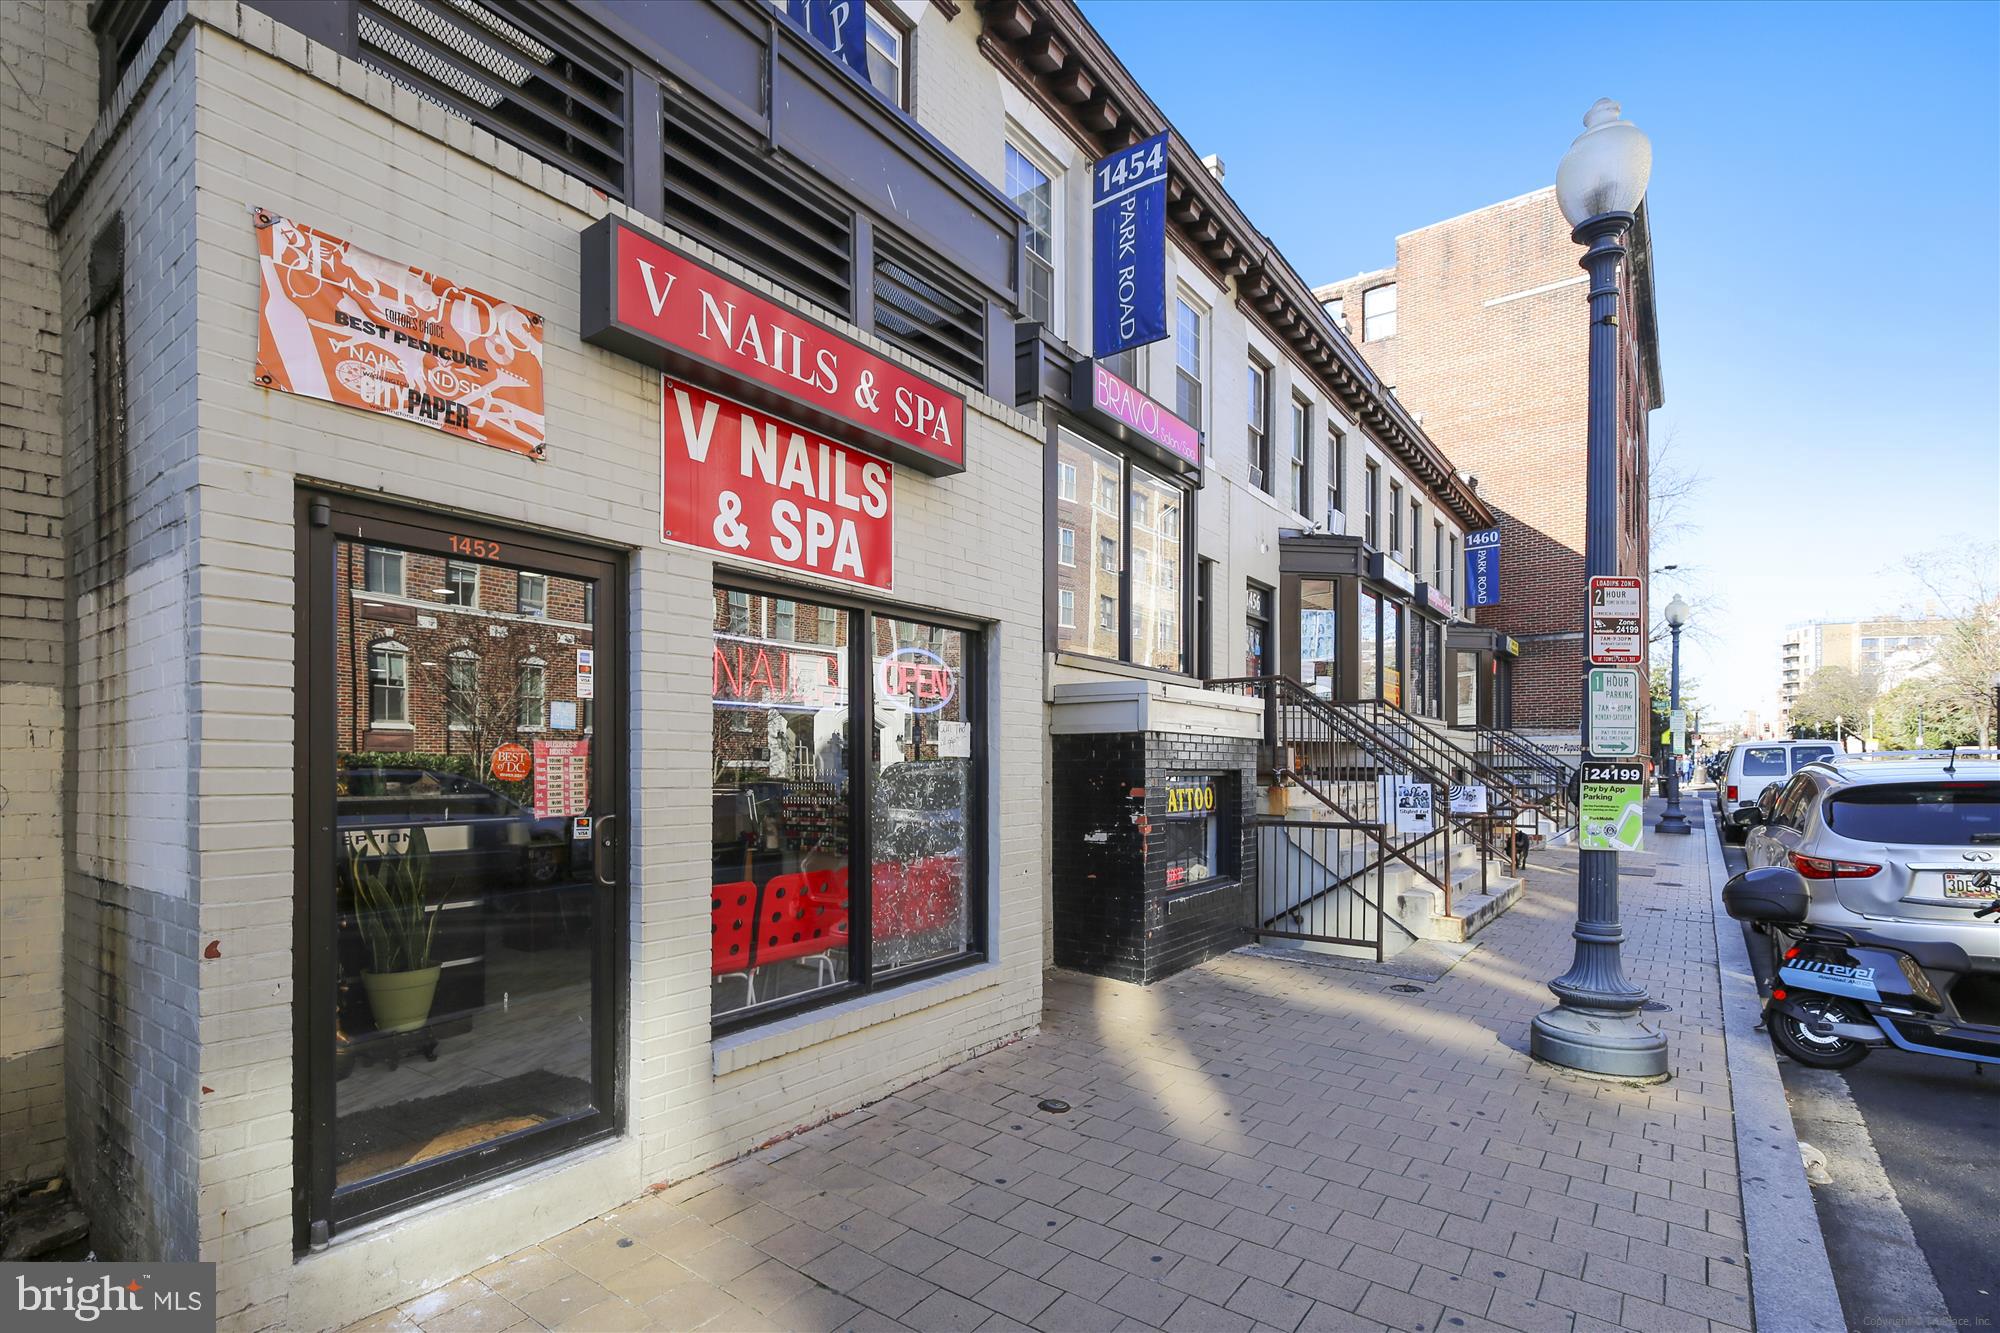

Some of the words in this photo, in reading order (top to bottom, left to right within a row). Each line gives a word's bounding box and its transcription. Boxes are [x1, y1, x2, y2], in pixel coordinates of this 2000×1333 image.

[1098, 142, 1164, 192] 1454
[1119, 195, 1136, 260] PARK
[1118, 269, 1135, 340] ROAD
[335, 311, 391, 339] BEST
[394, 329, 489, 372] PEDICURE
[419, 319, 445, 340] CHOICE
[636, 257, 677, 317] V
[698, 288, 838, 394] NAILS
[854, 369, 880, 414] &
[893, 386, 953, 447] SPA
[361, 377, 408, 412] CITY
[408, 388, 469, 430] PAPER
[1098, 369, 1159, 438] BRAVO!
[674, 388, 720, 463] V
[740, 413, 888, 519] NAILS
[713, 490, 750, 551] &
[770, 499, 865, 577] SPA
[1466, 531, 1499, 546] 1460
[449, 535, 500, 561] 1452
[1478, 550, 1487, 574] PARK
[1477, 576, 1487, 604] ROAD
[1595, 589, 1602, 605] 2
[1606, 590, 1626, 598] HOUR
[1616, 626, 1639, 634] 24199
[713, 645, 838, 702] NAILS
[884, 661, 950, 699] OPEN
[1595, 676, 1600, 690] 1
[1606, 677, 1629, 688] HOUR
[1606, 690, 1633, 700] PARKING
[498, 751, 527, 762] BEST
[1590, 768, 1640, 780] 24199
[1166, 784, 1214, 812] ATTOO
[1583, 785, 1598, 793] Pay
[1609, 786, 1626, 794] App
[1583, 793, 1613, 801] Parking
[1822, 963, 1876, 981] revel
